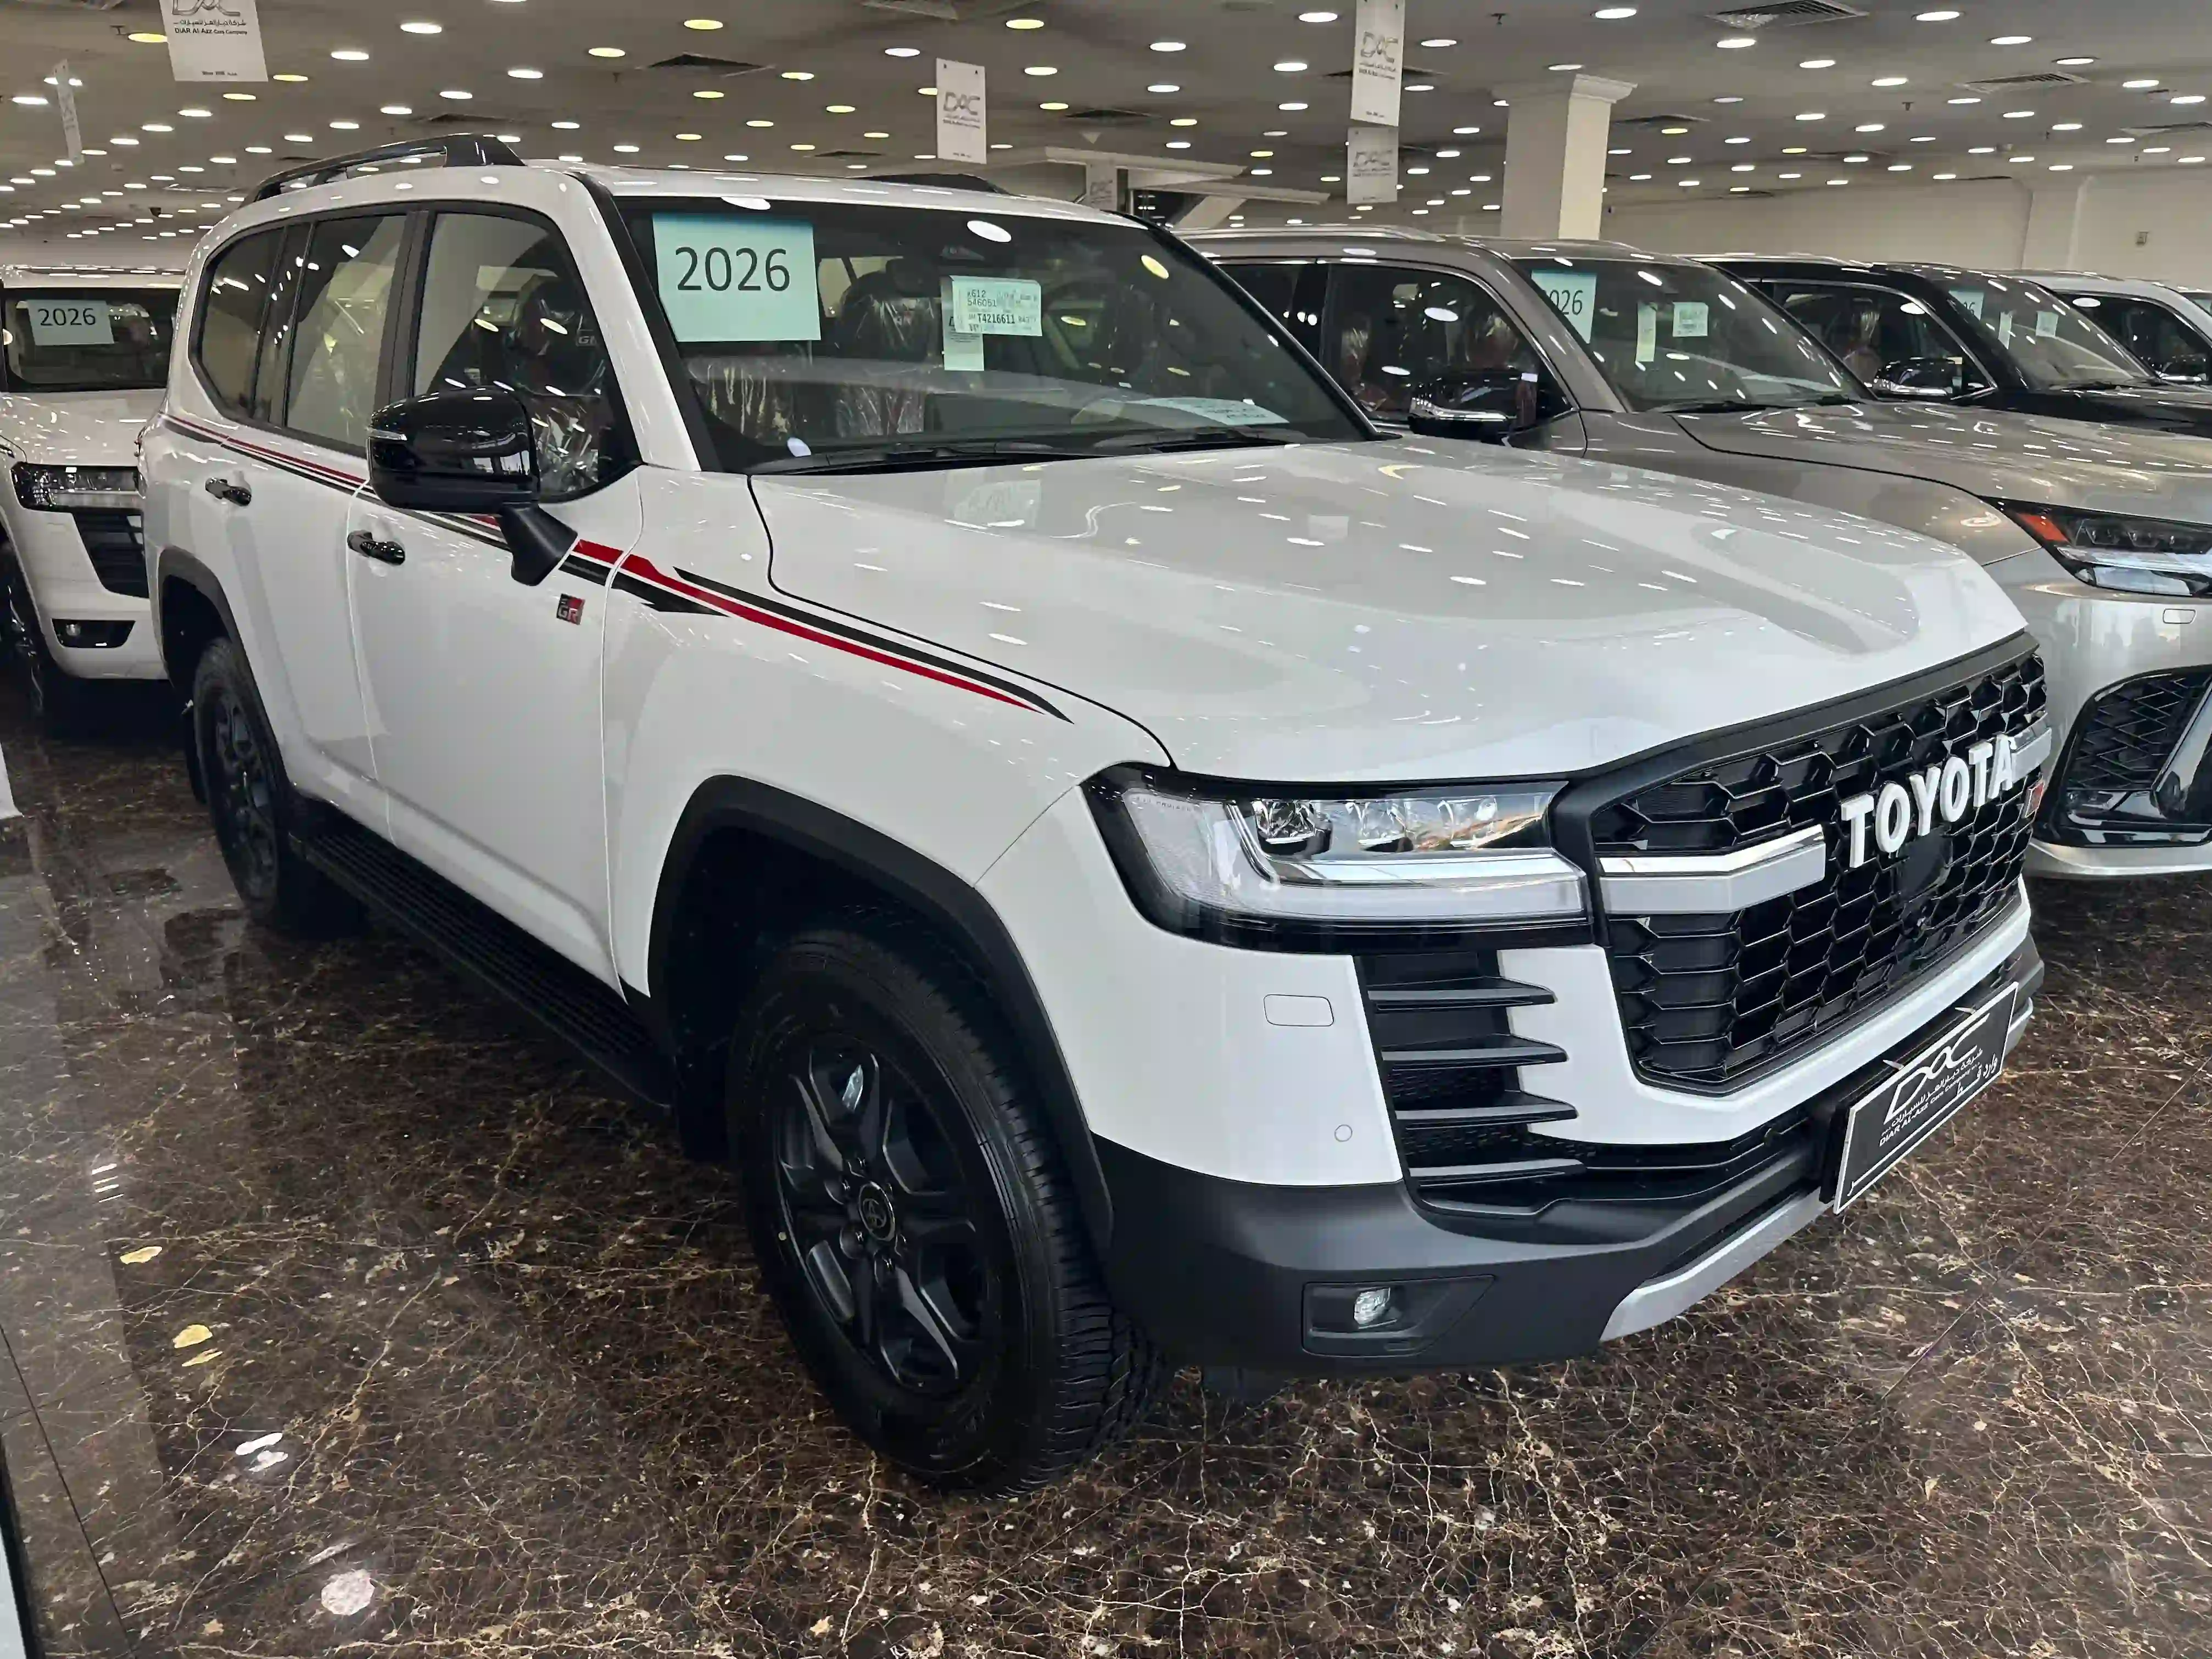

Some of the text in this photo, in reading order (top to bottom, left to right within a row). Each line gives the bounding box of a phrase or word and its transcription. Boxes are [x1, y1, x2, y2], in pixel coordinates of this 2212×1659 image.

[675, 247, 790, 292] 2026
[1546, 289, 1583, 315] 026
[38, 308, 96, 326] 2026
[977, 313, 1015, 324] T4216611
[1841, 734, 2014, 868] TOYOTA
[1879, 1123, 1901, 1147] DIAR
